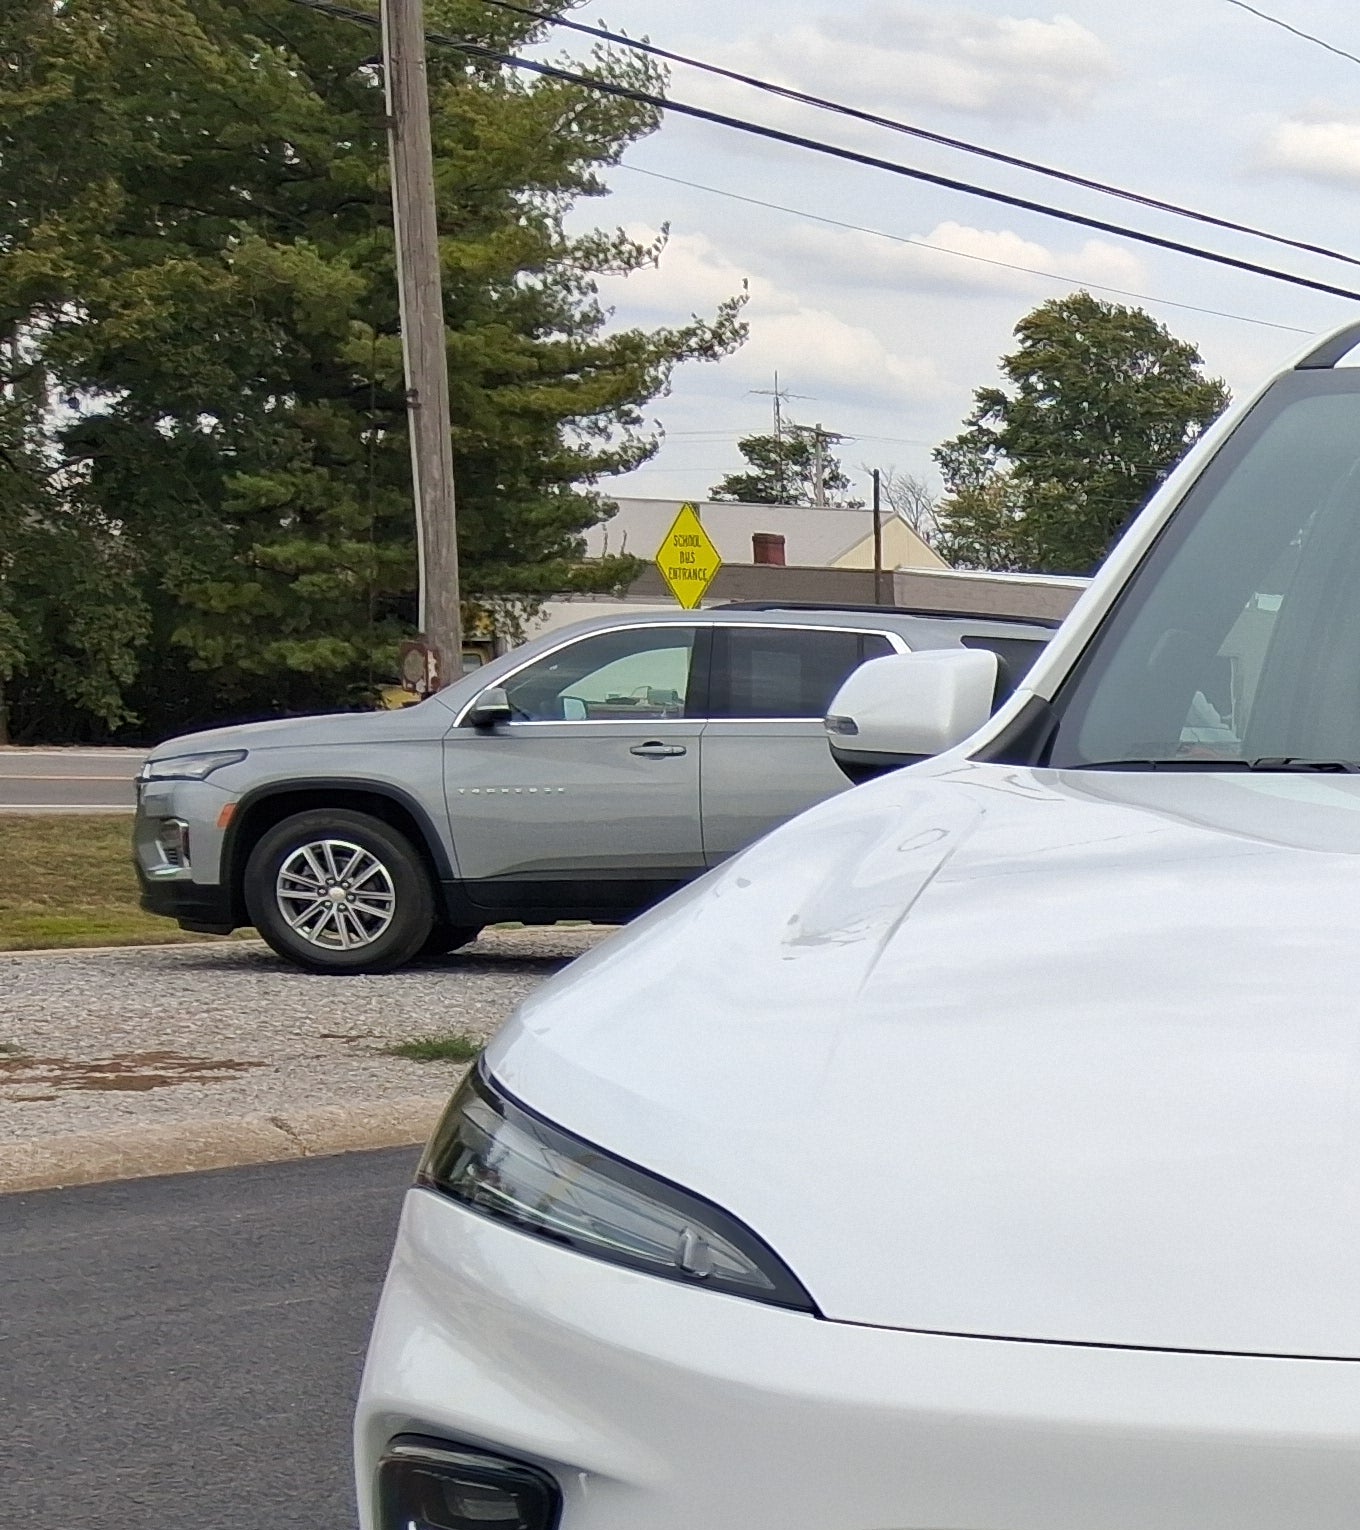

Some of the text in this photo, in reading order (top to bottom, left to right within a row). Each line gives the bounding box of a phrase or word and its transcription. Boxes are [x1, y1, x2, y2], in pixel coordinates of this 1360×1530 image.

[673, 535, 701, 547] SCHOOL
[680, 551, 695, 563] BUS
[668, 567, 707, 581] ENTRANCE
